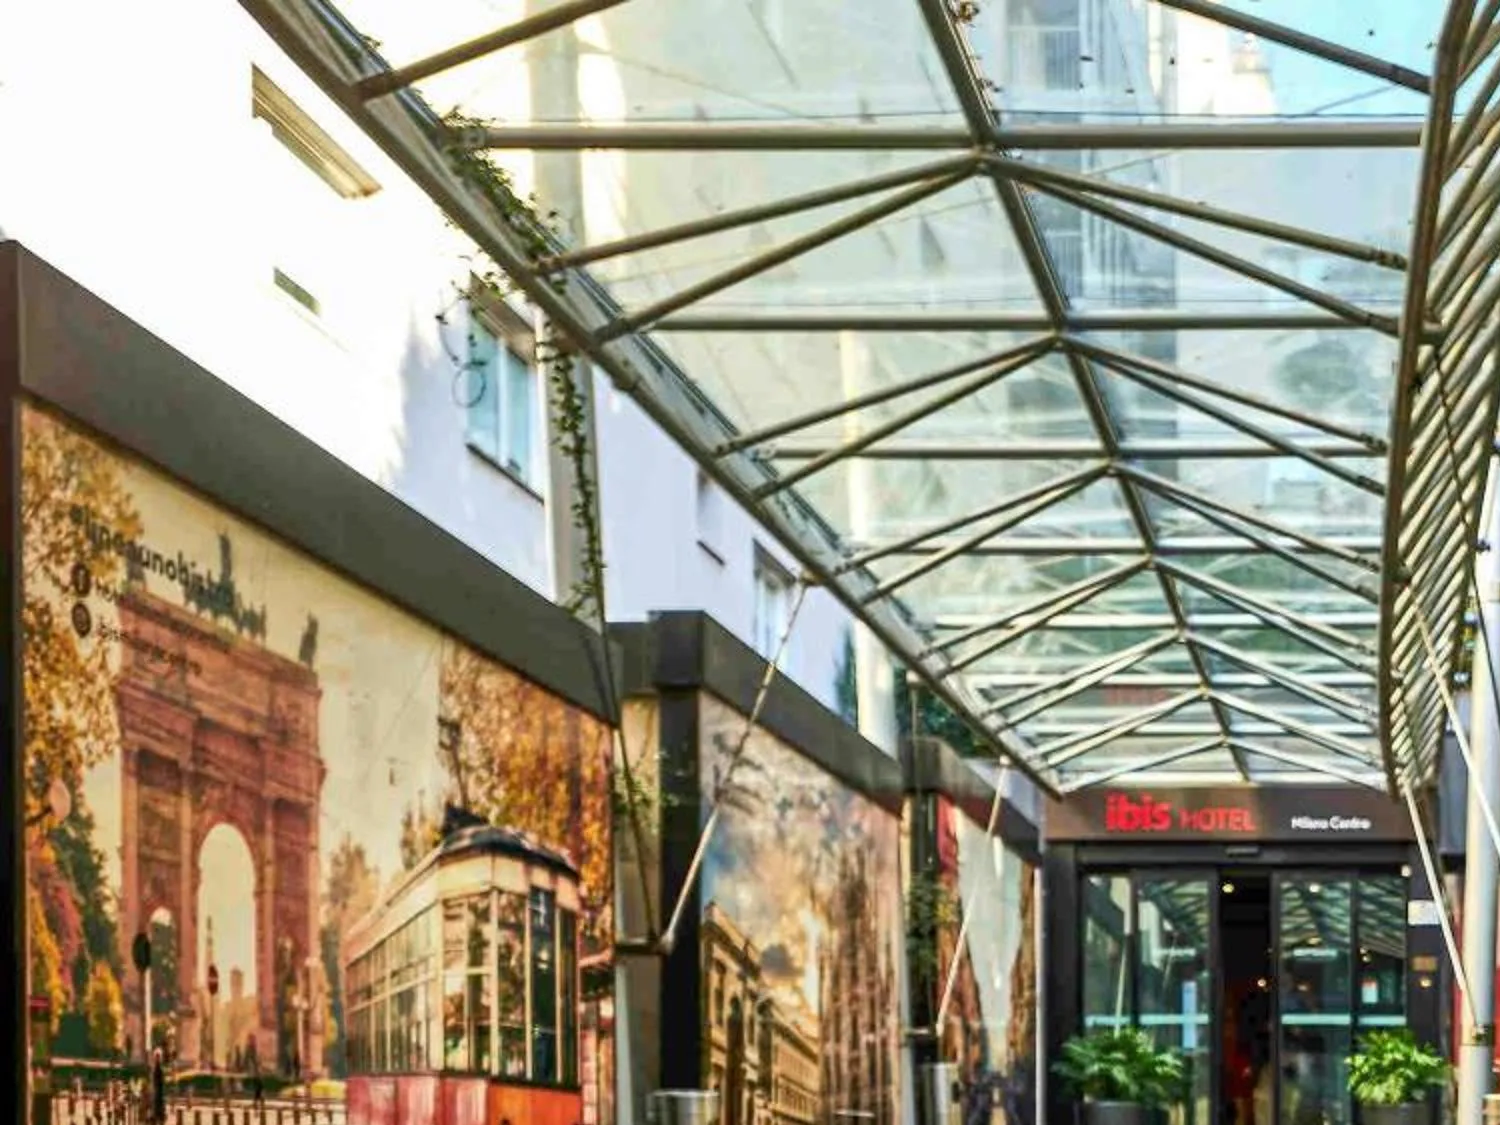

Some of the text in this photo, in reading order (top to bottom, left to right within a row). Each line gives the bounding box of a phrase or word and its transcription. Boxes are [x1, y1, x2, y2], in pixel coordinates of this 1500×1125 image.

[1104, 789, 1256, 833] ibis HOTEL
[1329, 815, 1372, 830] Centro
